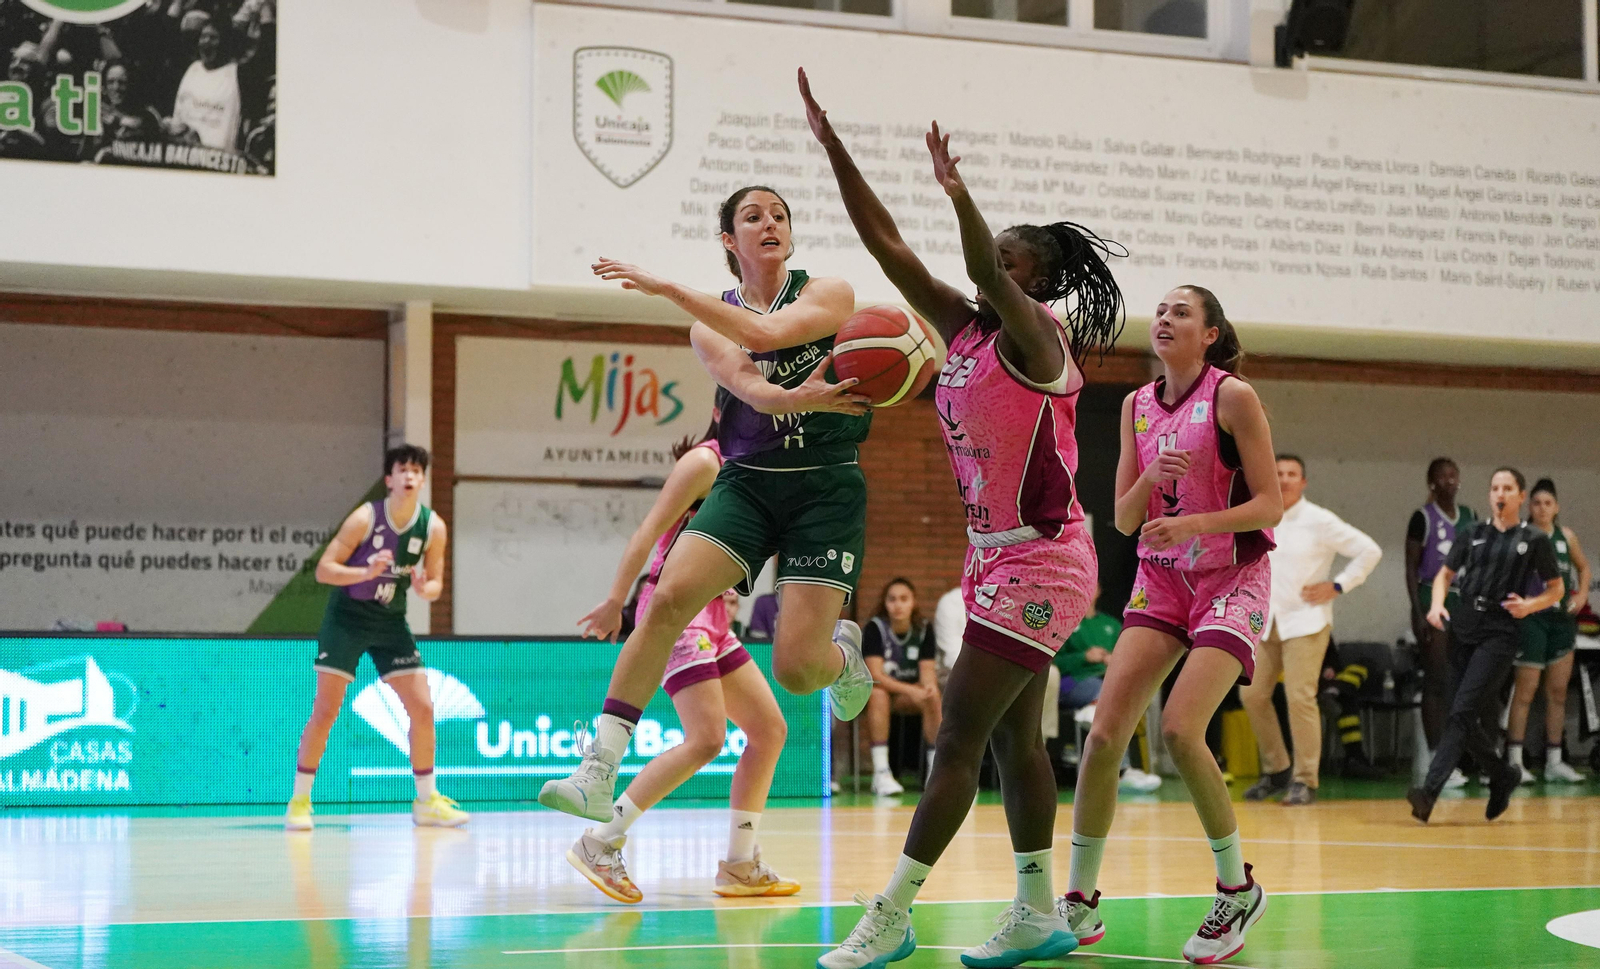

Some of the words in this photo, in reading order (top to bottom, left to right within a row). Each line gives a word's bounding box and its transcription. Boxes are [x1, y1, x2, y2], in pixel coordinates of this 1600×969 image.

[52, 72, 103, 136] ti
[594, 114, 651, 135] Unicaja
[938, 351, 978, 388] 22
[555, 353, 684, 436] Mijas
[543, 446, 675, 465] AYUNTAMIENT
[42, 520, 79, 543] qué
[152, 523, 206, 542] hacer
[212, 527, 244, 546] por
[269, 526, 287, 544] el
[98, 551, 135, 572] qué
[141, 553, 212, 574] puedes
[218, 553, 271, 571] hacer
[277, 553, 297, 572] tú
[1025, 604, 1052, 621] ADC
[50, 740, 133, 764] CASAS
